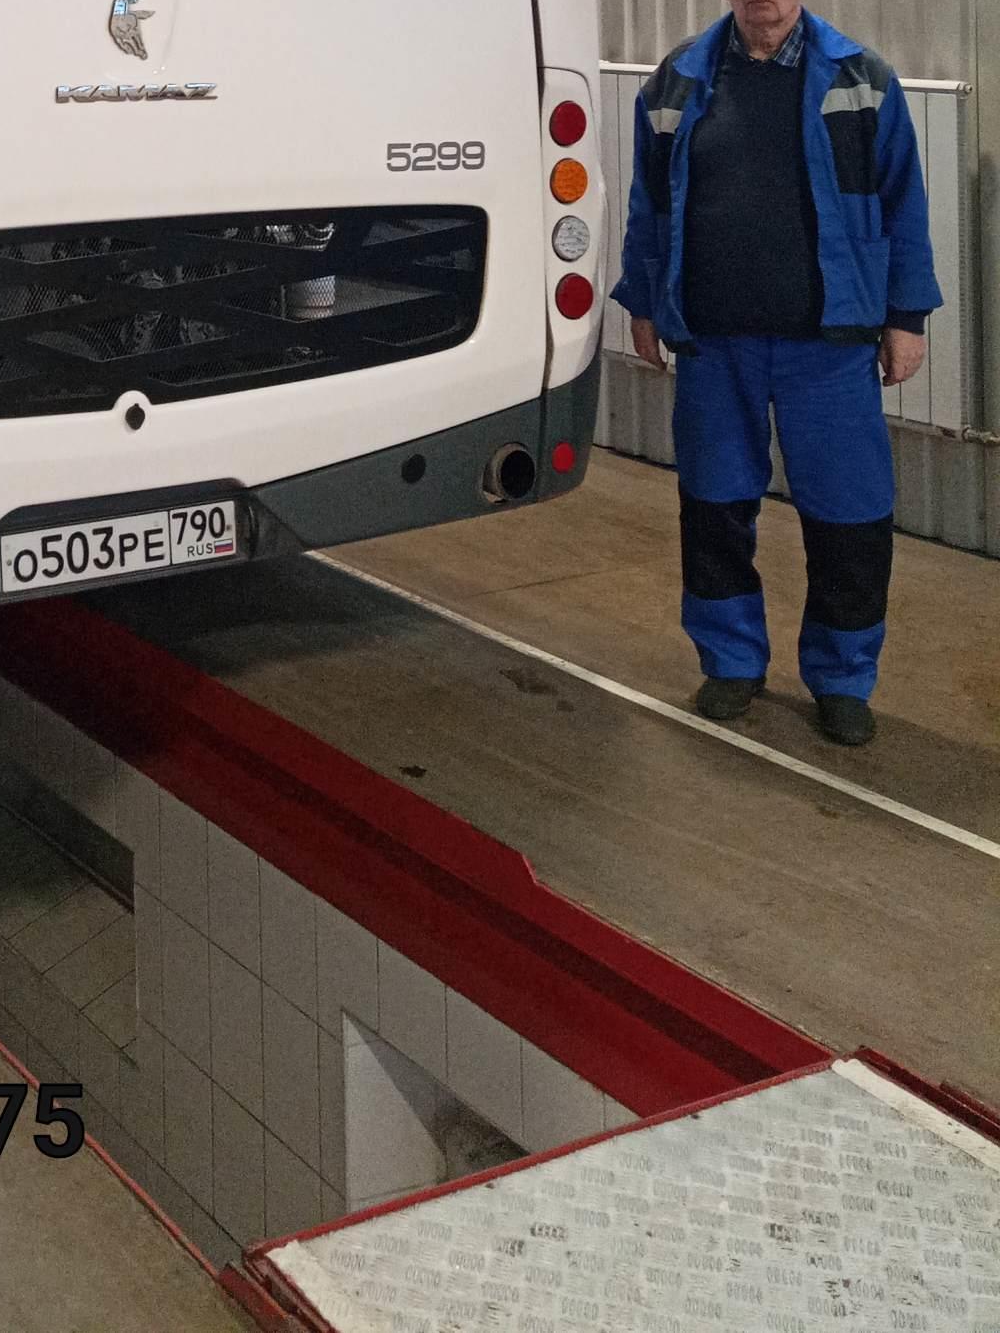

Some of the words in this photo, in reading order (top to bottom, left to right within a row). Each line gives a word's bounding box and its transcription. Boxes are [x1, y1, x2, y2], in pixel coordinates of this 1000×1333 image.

[54, 82, 219, 105] KAMAZ
[386, 140, 486, 172] 5299
[171, 506, 226, 546] 790
[186, 542, 214, 558] RUS
